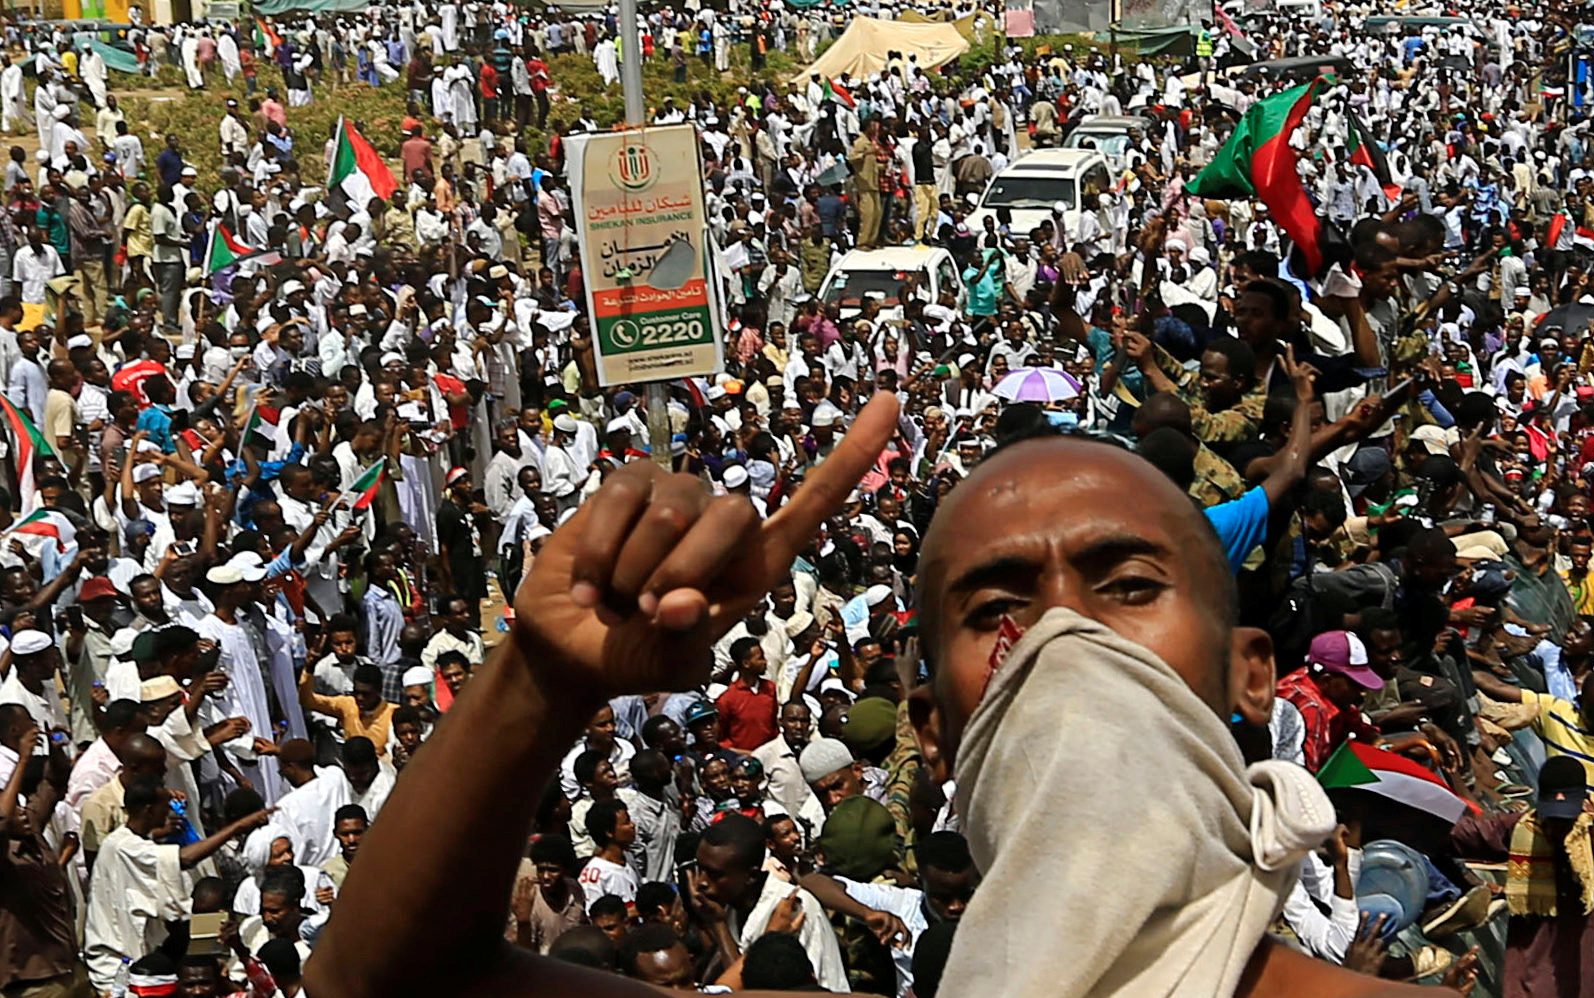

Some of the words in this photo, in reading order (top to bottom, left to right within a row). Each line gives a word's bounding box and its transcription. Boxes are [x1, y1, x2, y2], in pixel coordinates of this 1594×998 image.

[644, 195, 692, 213] شيكان
[589, 219, 634, 231] SHIEKAN
[635, 211, 694, 225] INSURANCE
[640, 314, 681, 326] Customer
[680, 311, 703, 321] Care
[641, 320, 704, 346] 2220
